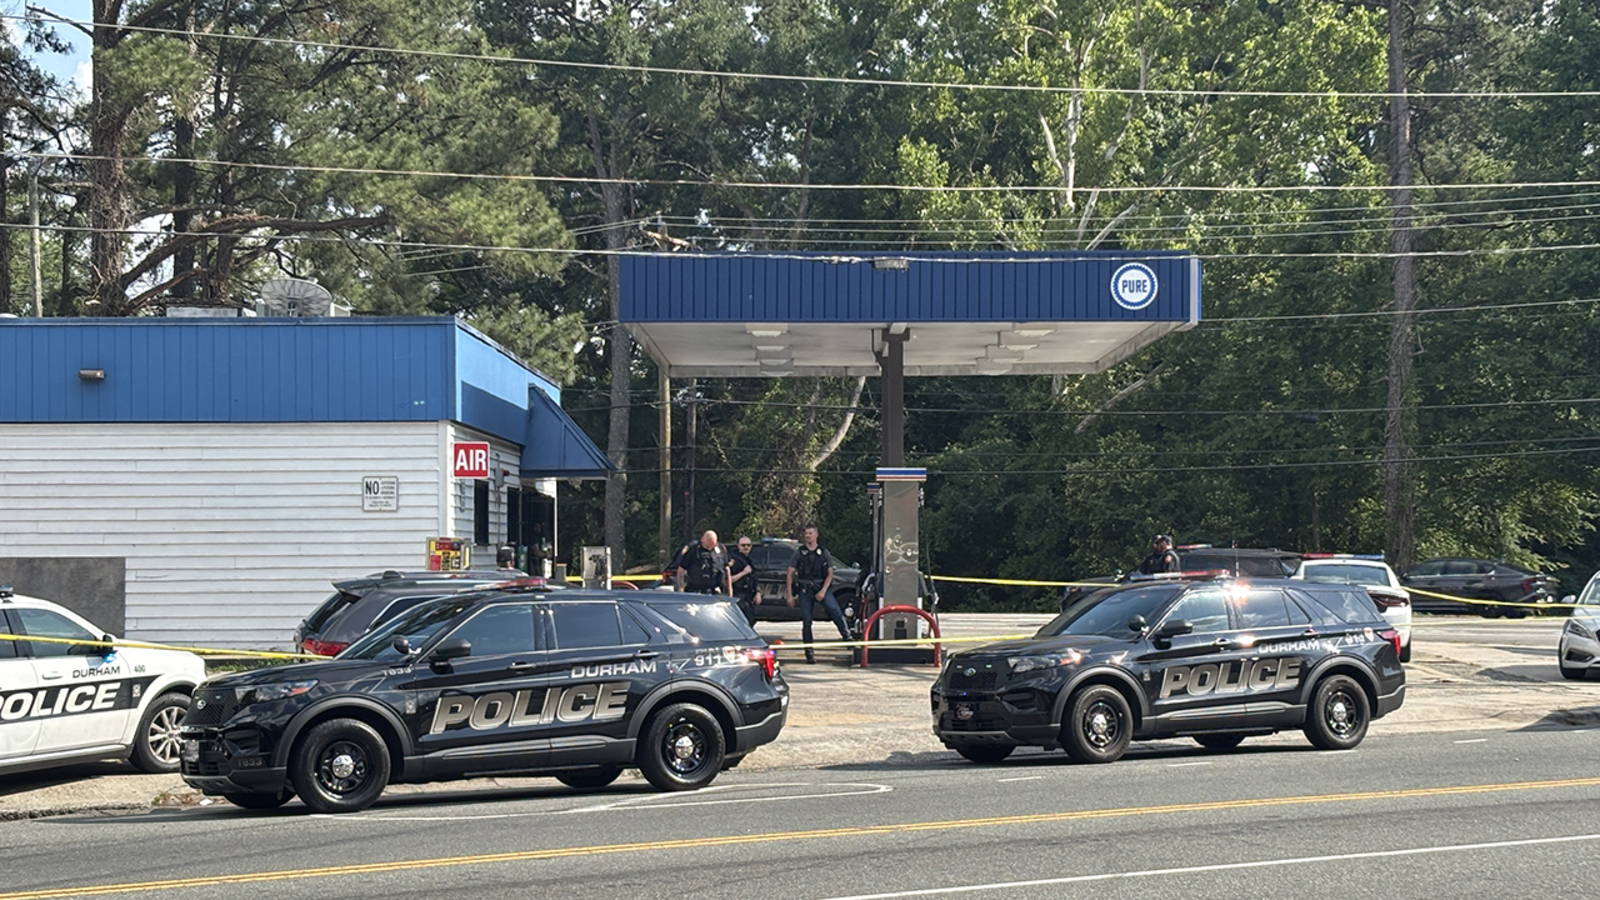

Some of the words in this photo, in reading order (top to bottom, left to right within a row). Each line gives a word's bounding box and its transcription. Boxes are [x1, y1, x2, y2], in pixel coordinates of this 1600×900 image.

[1121, 279, 1148, 293] PURE
[455, 449, 487, 471] AIR
[365, 480, 380, 495] NO
[1258, 640, 1320, 653] DURHAM
[694, 654, 722, 666] 911
[72, 665, 121, 679] DURHAM
[571, 661, 657, 678] DURHAM
[1159, 657, 1301, 698] POLICE
[429, 682, 632, 735] POLICE
